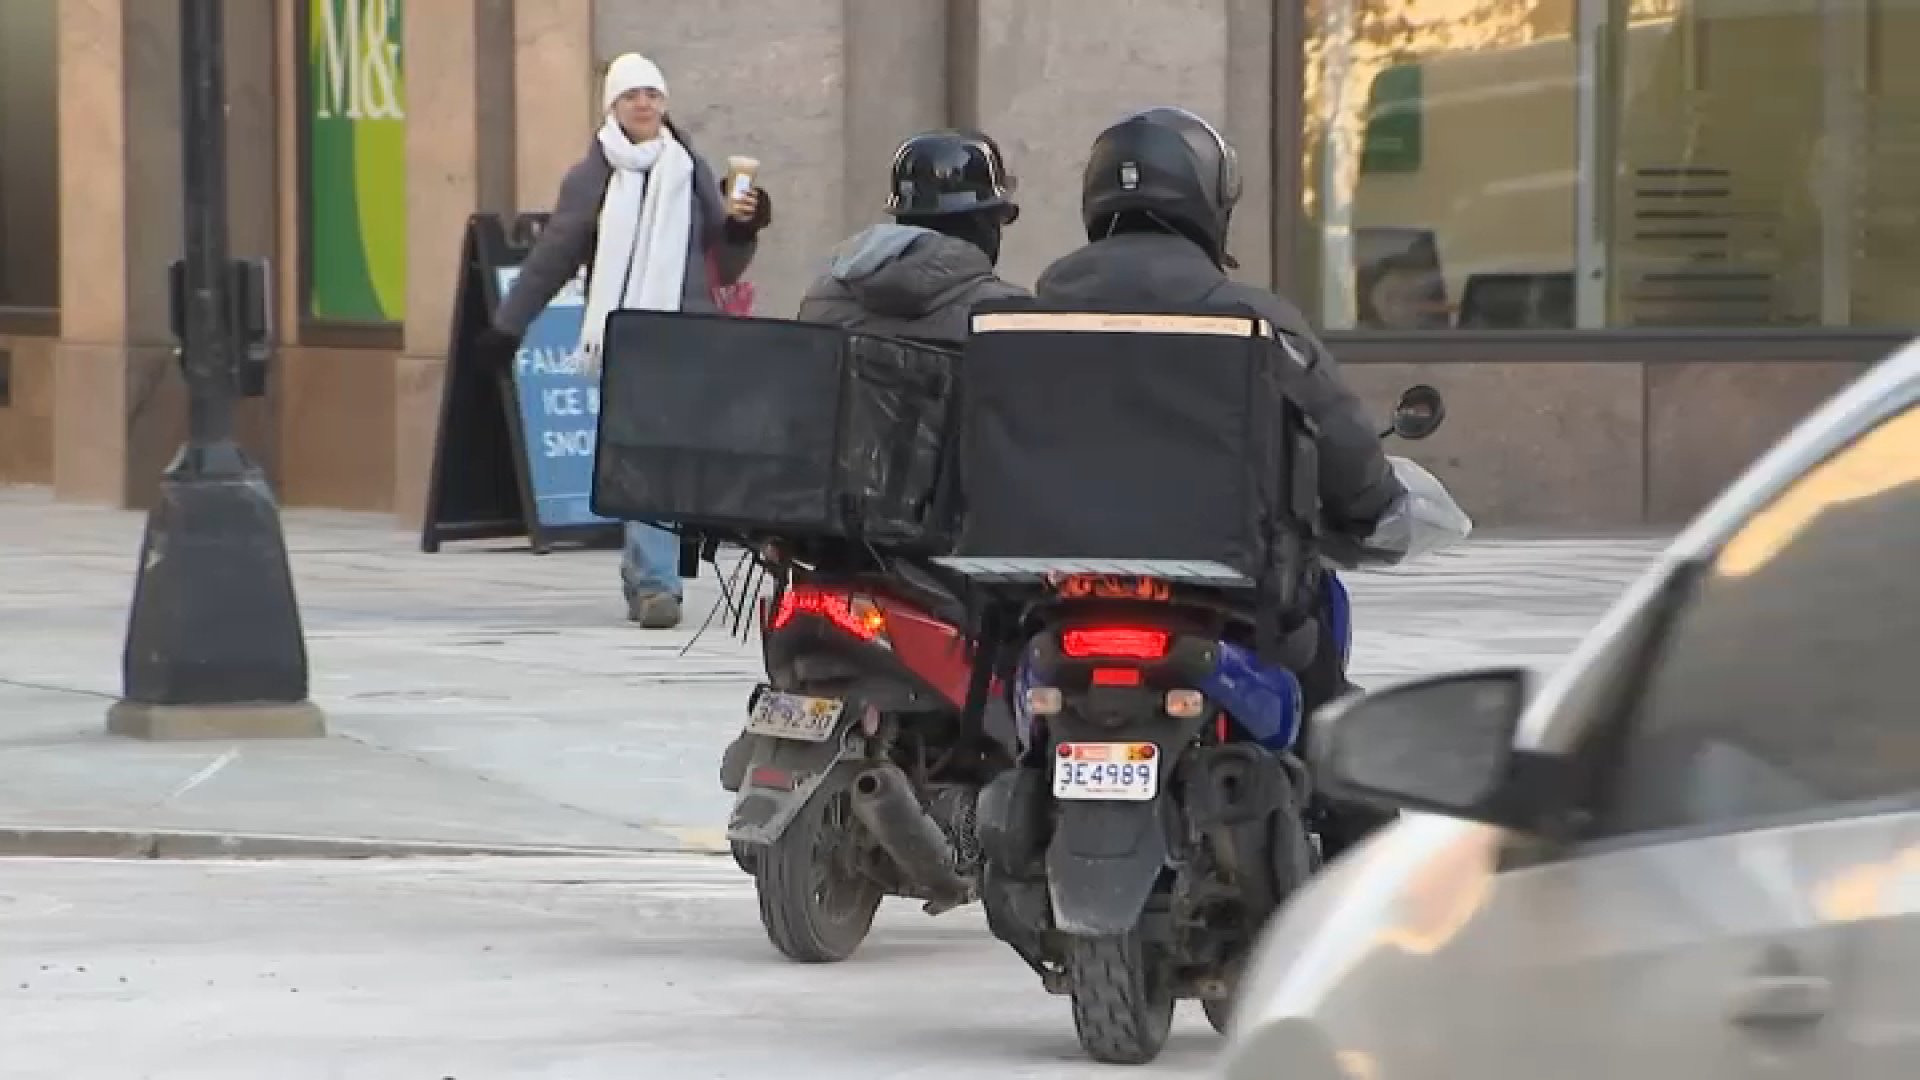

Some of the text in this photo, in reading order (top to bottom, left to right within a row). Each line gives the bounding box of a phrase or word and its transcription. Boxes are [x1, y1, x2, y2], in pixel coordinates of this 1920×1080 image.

[317, 0, 405, 118] M&
[543, 387, 582, 415] ICE
[543, 430, 593, 457] SNO
[1060, 762, 1150, 786] 3E4989
